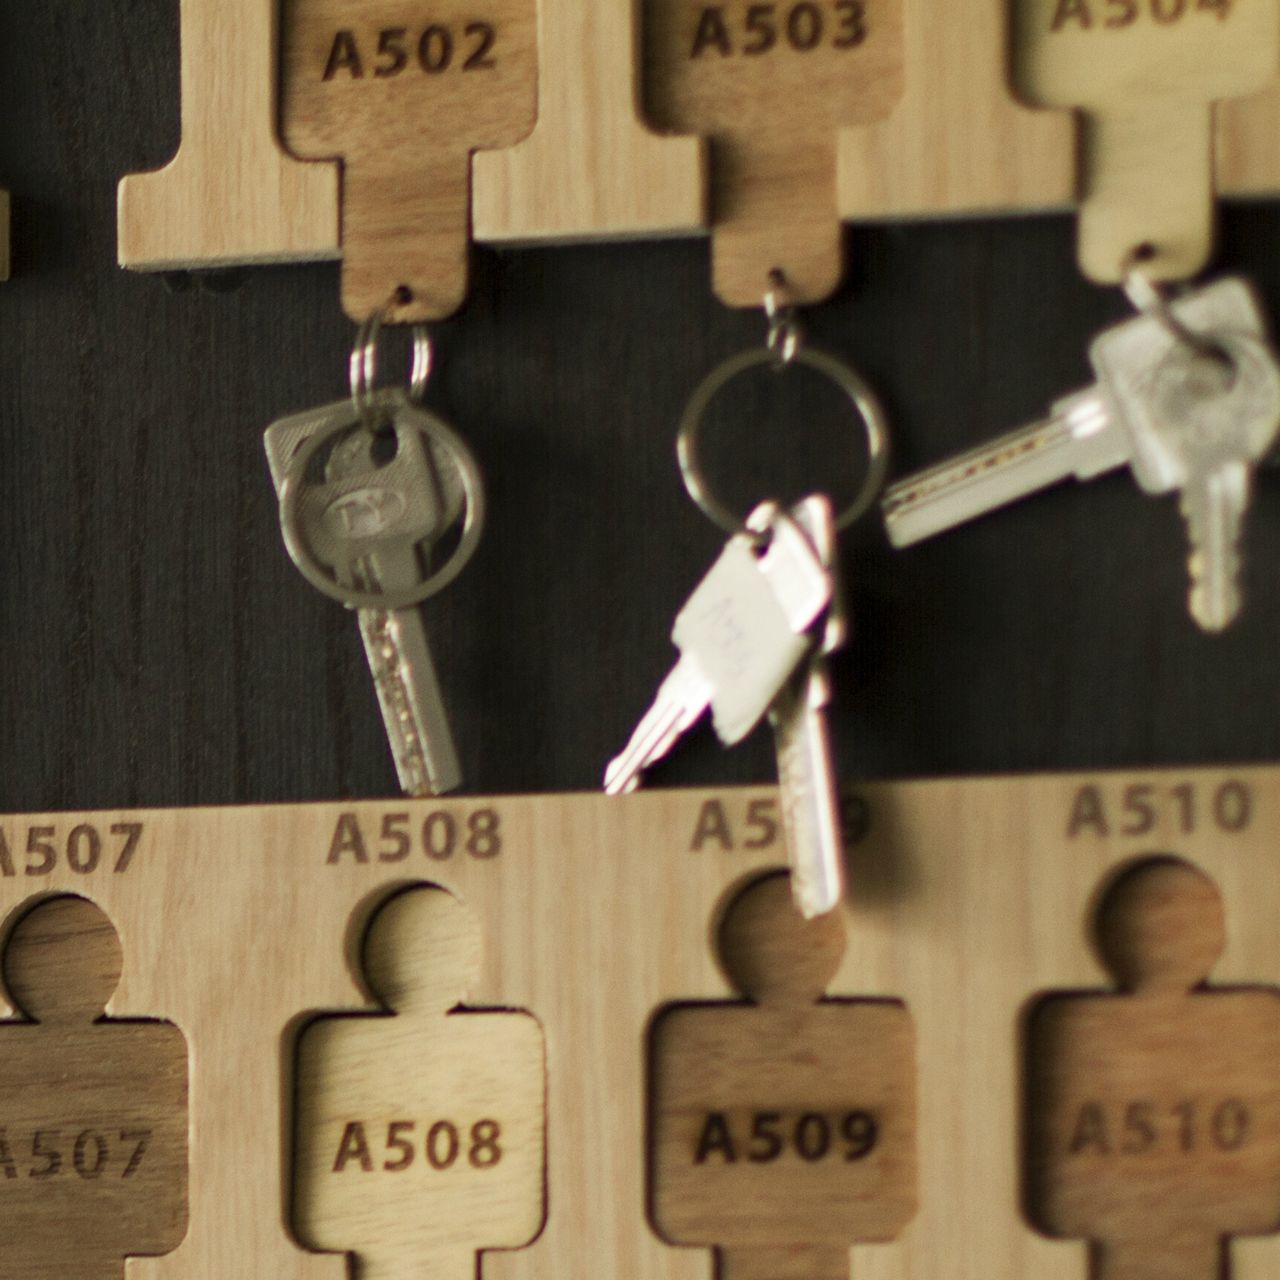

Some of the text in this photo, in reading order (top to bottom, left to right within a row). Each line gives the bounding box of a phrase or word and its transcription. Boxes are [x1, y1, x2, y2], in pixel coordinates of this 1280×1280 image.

[322, 22, 497, 81] A502
[690, 1, 868, 60] A503
[327, 809, 502, 865] A508
[690, 796, 872, 852] A59
[1067, 781, 1252, 840] A510
[332, 1119, 502, 1173] A508
[694, 1110, 880, 1165] A509
[1068, 1099, 1250, 1155] A510
